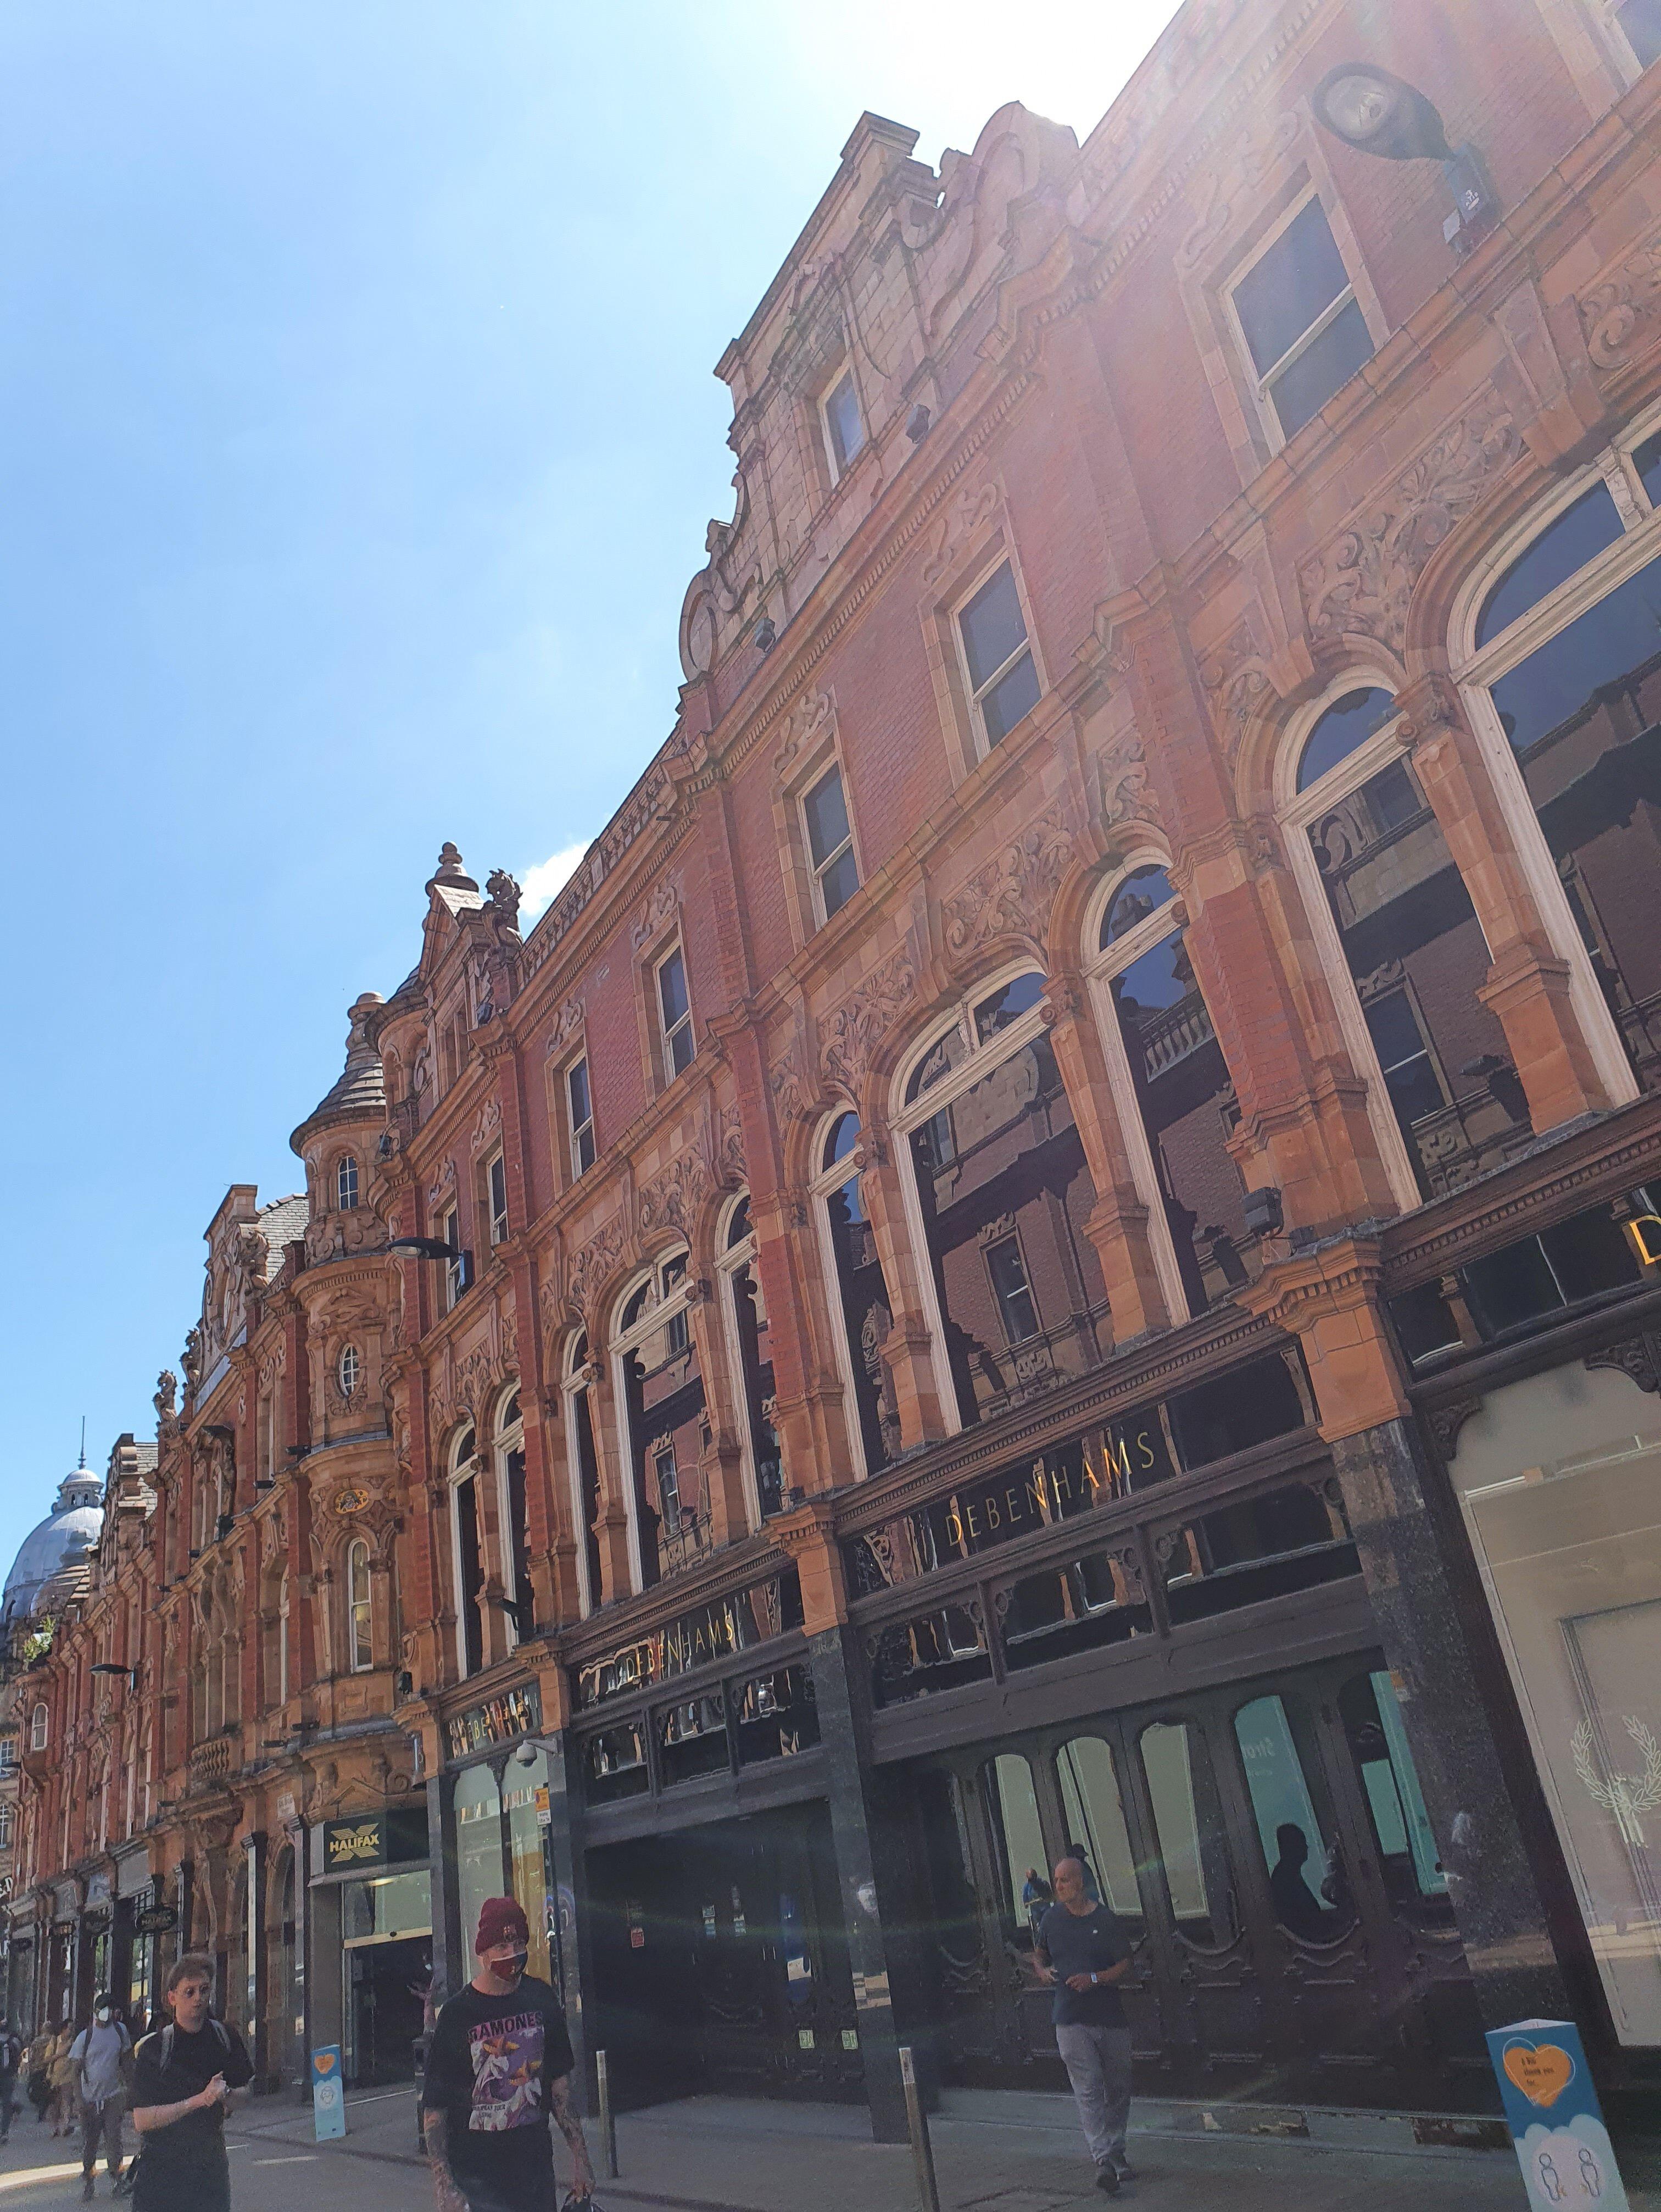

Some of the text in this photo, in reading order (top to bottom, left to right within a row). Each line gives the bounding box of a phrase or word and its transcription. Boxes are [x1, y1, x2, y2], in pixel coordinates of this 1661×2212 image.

[945, 1432, 1154, 1547] DEBENHAMS
[626, 1615, 733, 1682] DEBENHAMS
[330, 1833, 380, 1852] HALIFAX
[467, 2011, 543, 2042] RAMONES
